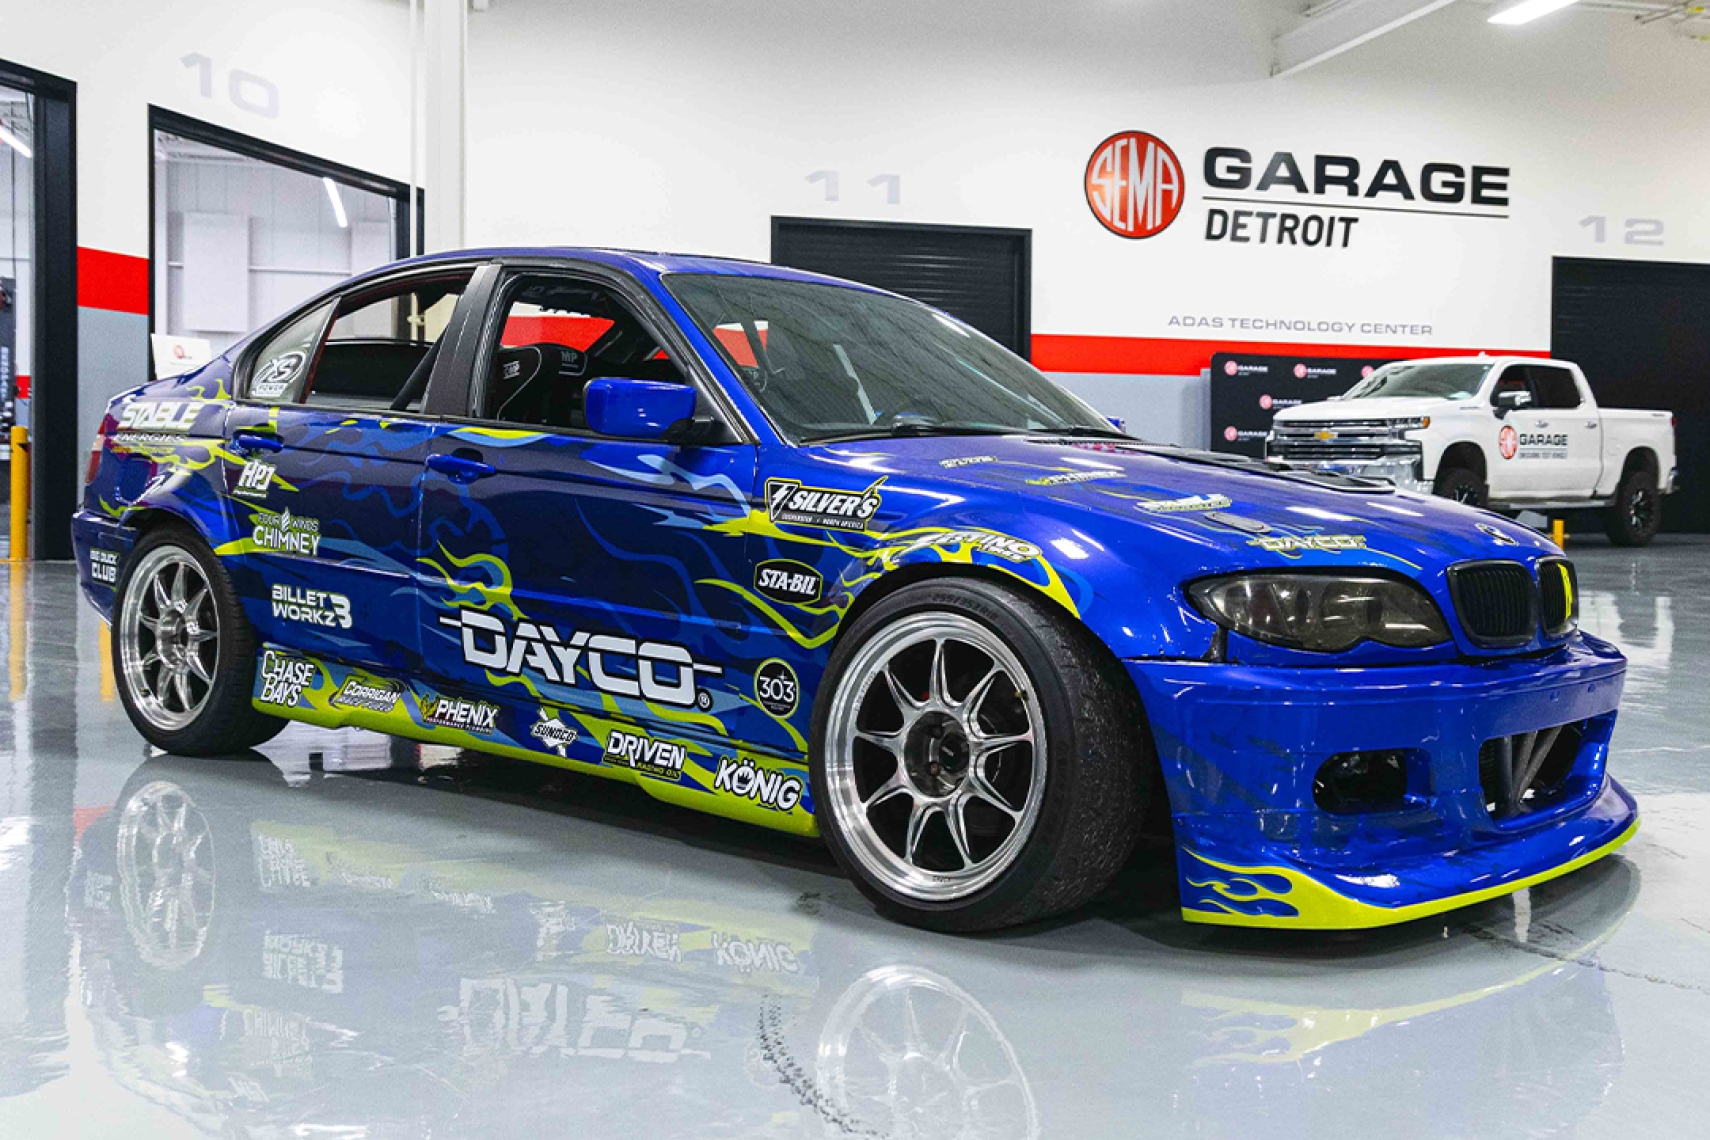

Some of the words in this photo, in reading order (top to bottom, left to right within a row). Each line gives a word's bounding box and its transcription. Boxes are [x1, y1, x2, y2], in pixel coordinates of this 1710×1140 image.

[180, 52, 280, 119] 10
[1090, 136, 1180, 233] SEMA
[1203, 146, 1510, 207] GARAGE
[1204, 208, 1360, 248] DETROIT
[1579, 215, 1665, 246] 12
[1168, 315, 1224, 329] ADAS
[1228, 317, 1356, 333] TECHNOLOGY
[1360, 322, 1433, 335] CENTER
[119, 401, 204, 429] STABLE
[1519, 433, 1569, 446] GARAGE
[788, 484, 879, 519] SILVER'S
[258, 512, 281, 525] FOUR
[292, 518, 319, 532] WINDS
[252, 524, 321, 556] CHIMNEY
[91, 561, 117, 584] CLUB
[758, 568, 817, 596] STA-BIL
[271, 584, 328, 608] BILLET
[271, 601, 337, 628] WORKZ
[262, 650, 315, 686] CHASE
[440, 608, 723, 708] DAYCO
[260, 673, 302, 707] BAYS
[343, 680, 401, 704] CORRIGAN
[758, 675, 796, 704] 303
[435, 699, 498, 729] PHENIX
[534, 723, 576, 743] SUNOCO
[607, 730, 686, 770] DRIVEN
[714, 758, 801, 811] KÖNIG
